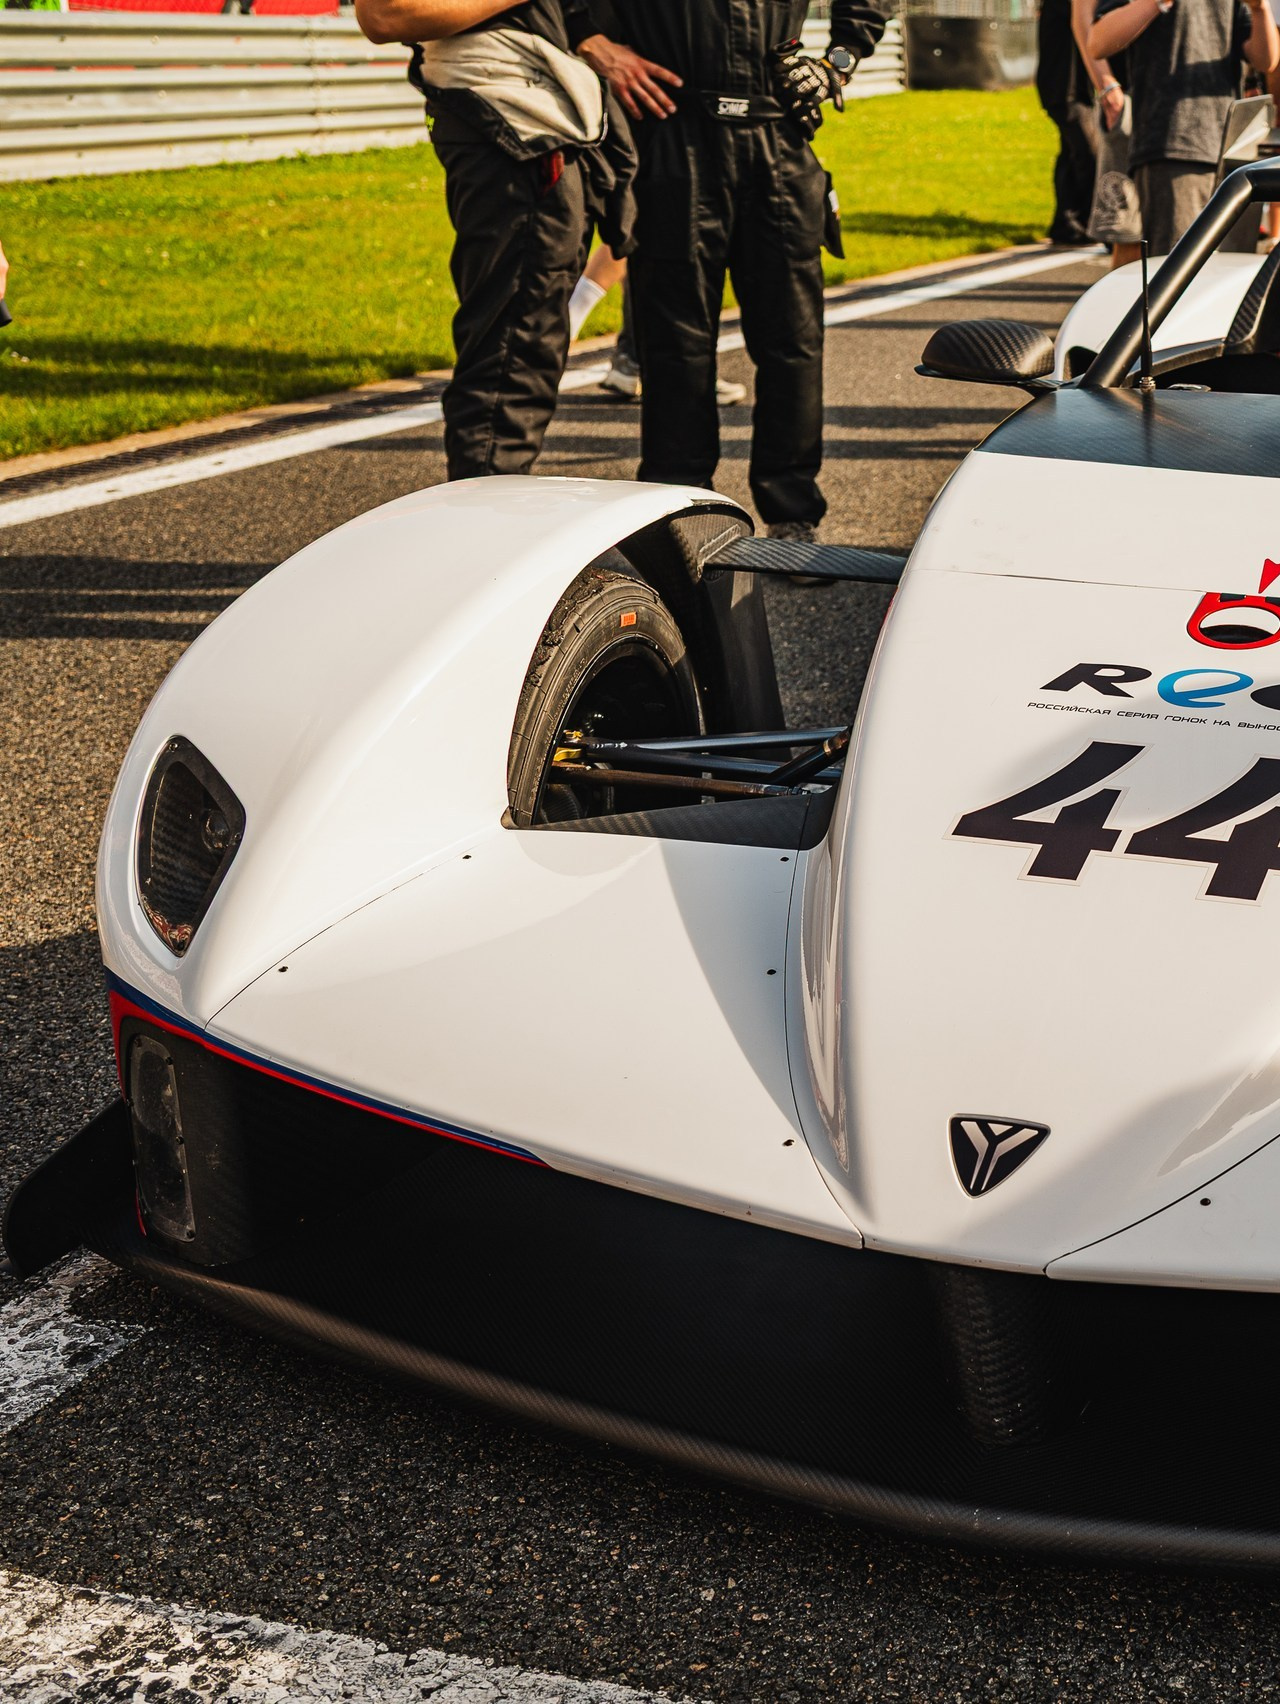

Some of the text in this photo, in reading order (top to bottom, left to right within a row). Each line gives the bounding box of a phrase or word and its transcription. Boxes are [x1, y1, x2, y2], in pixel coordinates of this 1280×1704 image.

[1027, 702, 1112, 716] РОССИЙСКАЯ
[1116, 710, 1160, 720] СЕРИЯ
[1164, 715, 1208, 725] ГОНОК
[1212, 719, 1231, 727] НА
